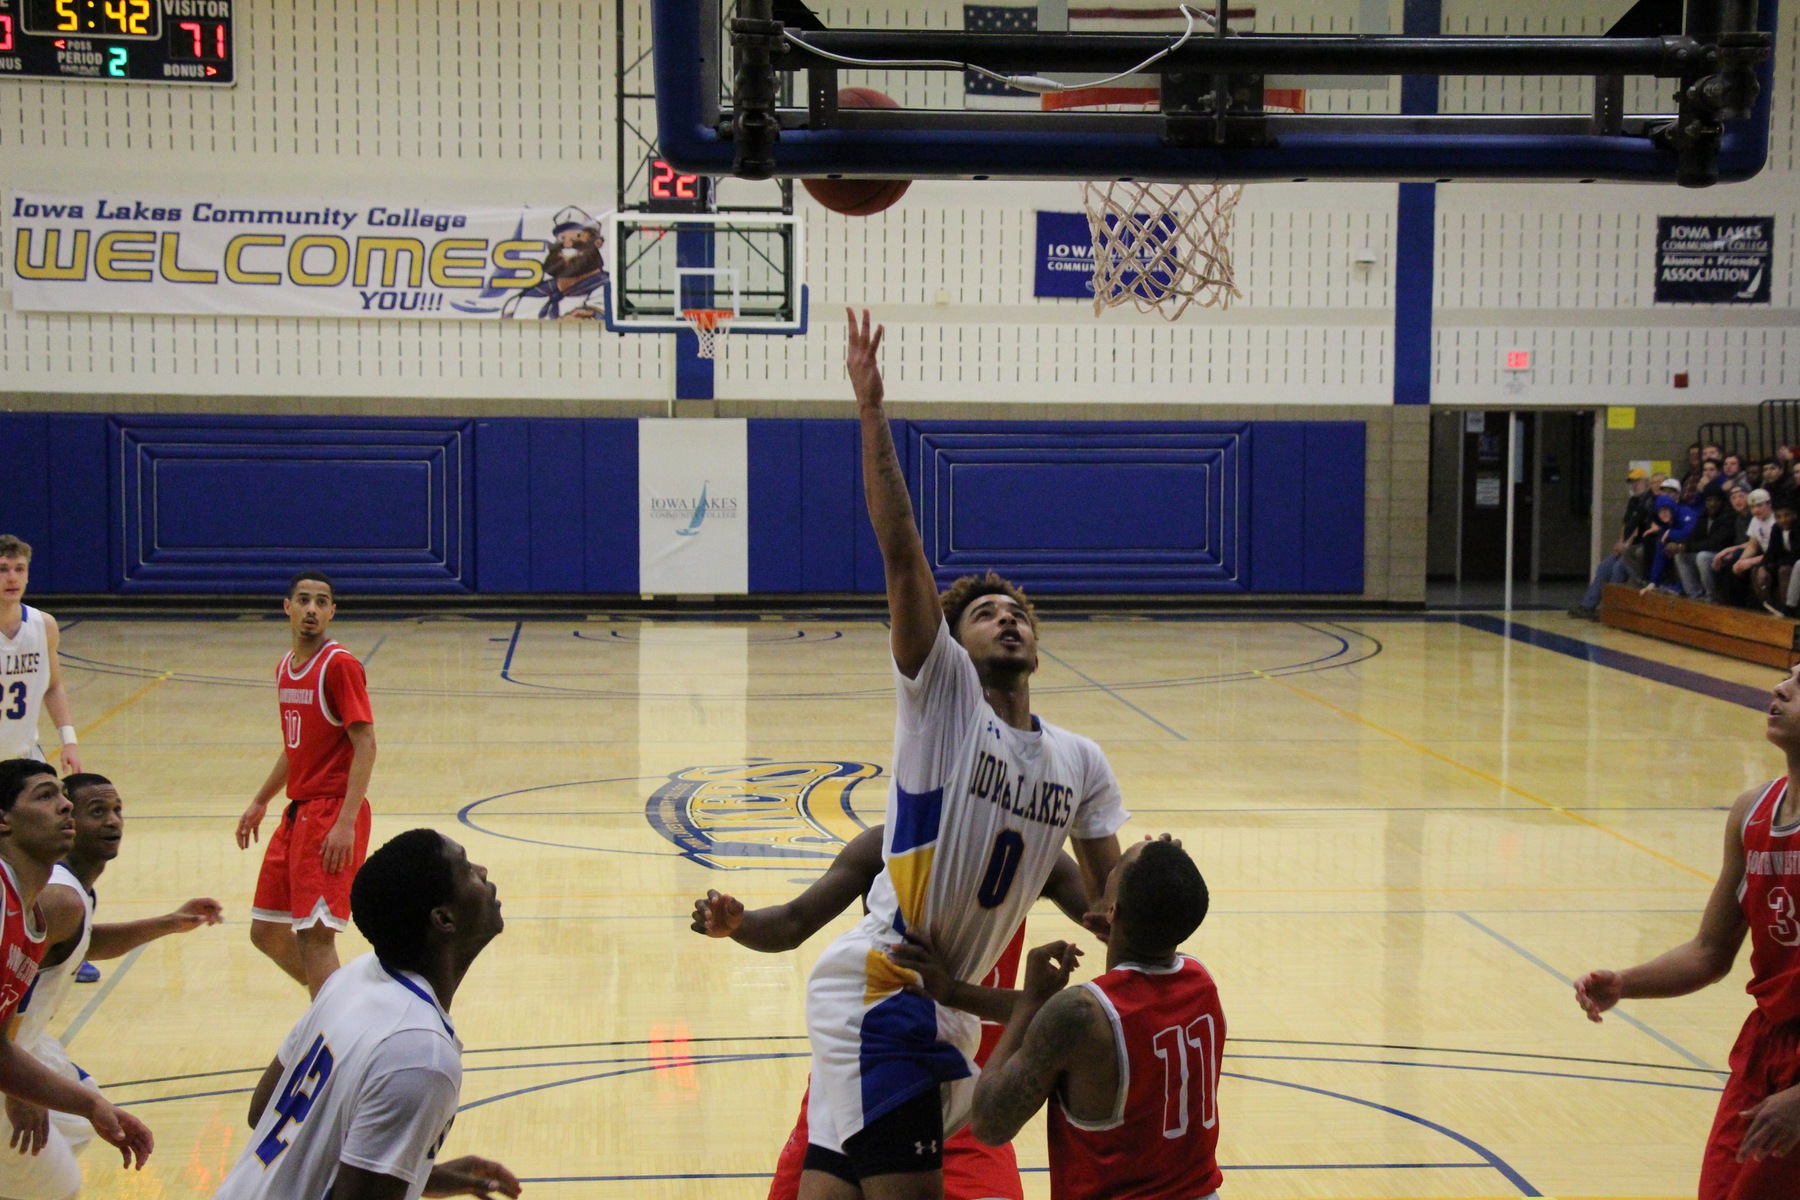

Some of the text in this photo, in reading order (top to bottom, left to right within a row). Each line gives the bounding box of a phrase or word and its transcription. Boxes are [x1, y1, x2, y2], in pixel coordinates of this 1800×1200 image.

[164, 0, 229, 18] VISITOR
[179, 22, 225, 58] 71
[57, 51, 103, 66] PERIOD
[109, 47, 127, 77] 2
[163, 63, 205, 78] BONUS
[13, 198, 466, 231] Iowa Lakes Community College
[1671, 226, 1762, 239] IOWA LAKES
[1662, 268, 1750, 281] ASSOCIATION
[360, 291, 443, 311] YOU!!!
[651, 498, 688, 509] IOWA
[6, 652, 40, 675] LAKES
[1012, 775, 1073, 827] LAKES
[977, 828, 1025, 910] 0
[1153, 1013, 1216, 1140] 11
